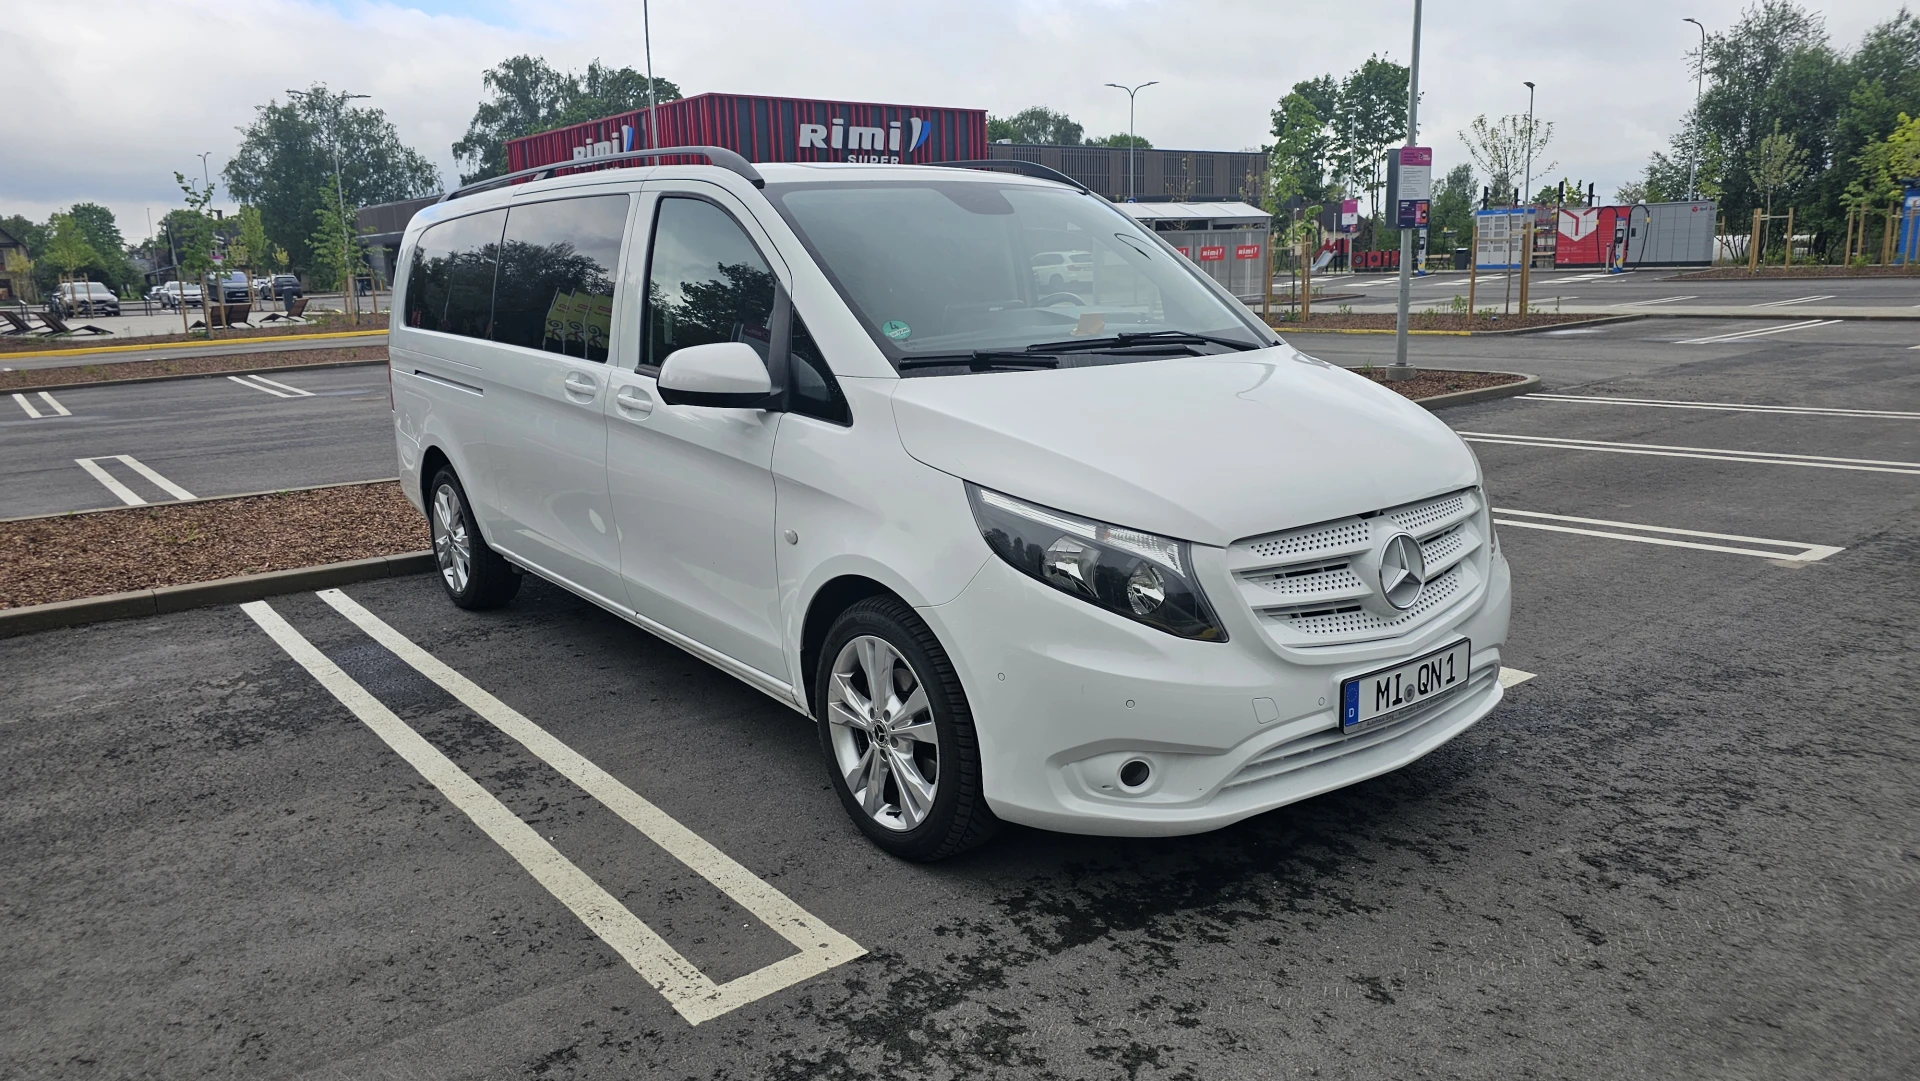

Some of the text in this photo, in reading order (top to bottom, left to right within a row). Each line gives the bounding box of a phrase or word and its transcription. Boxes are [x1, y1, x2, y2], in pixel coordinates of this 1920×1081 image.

[799, 118, 901, 151] Rimi
[573, 132, 620, 168] Rimi
[848, 155, 899, 164] SUPER
[1376, 673, 1403, 711] MI
[1348, 707, 1355, 718] D
[1367, 716, 1385, 726] Autohaus
